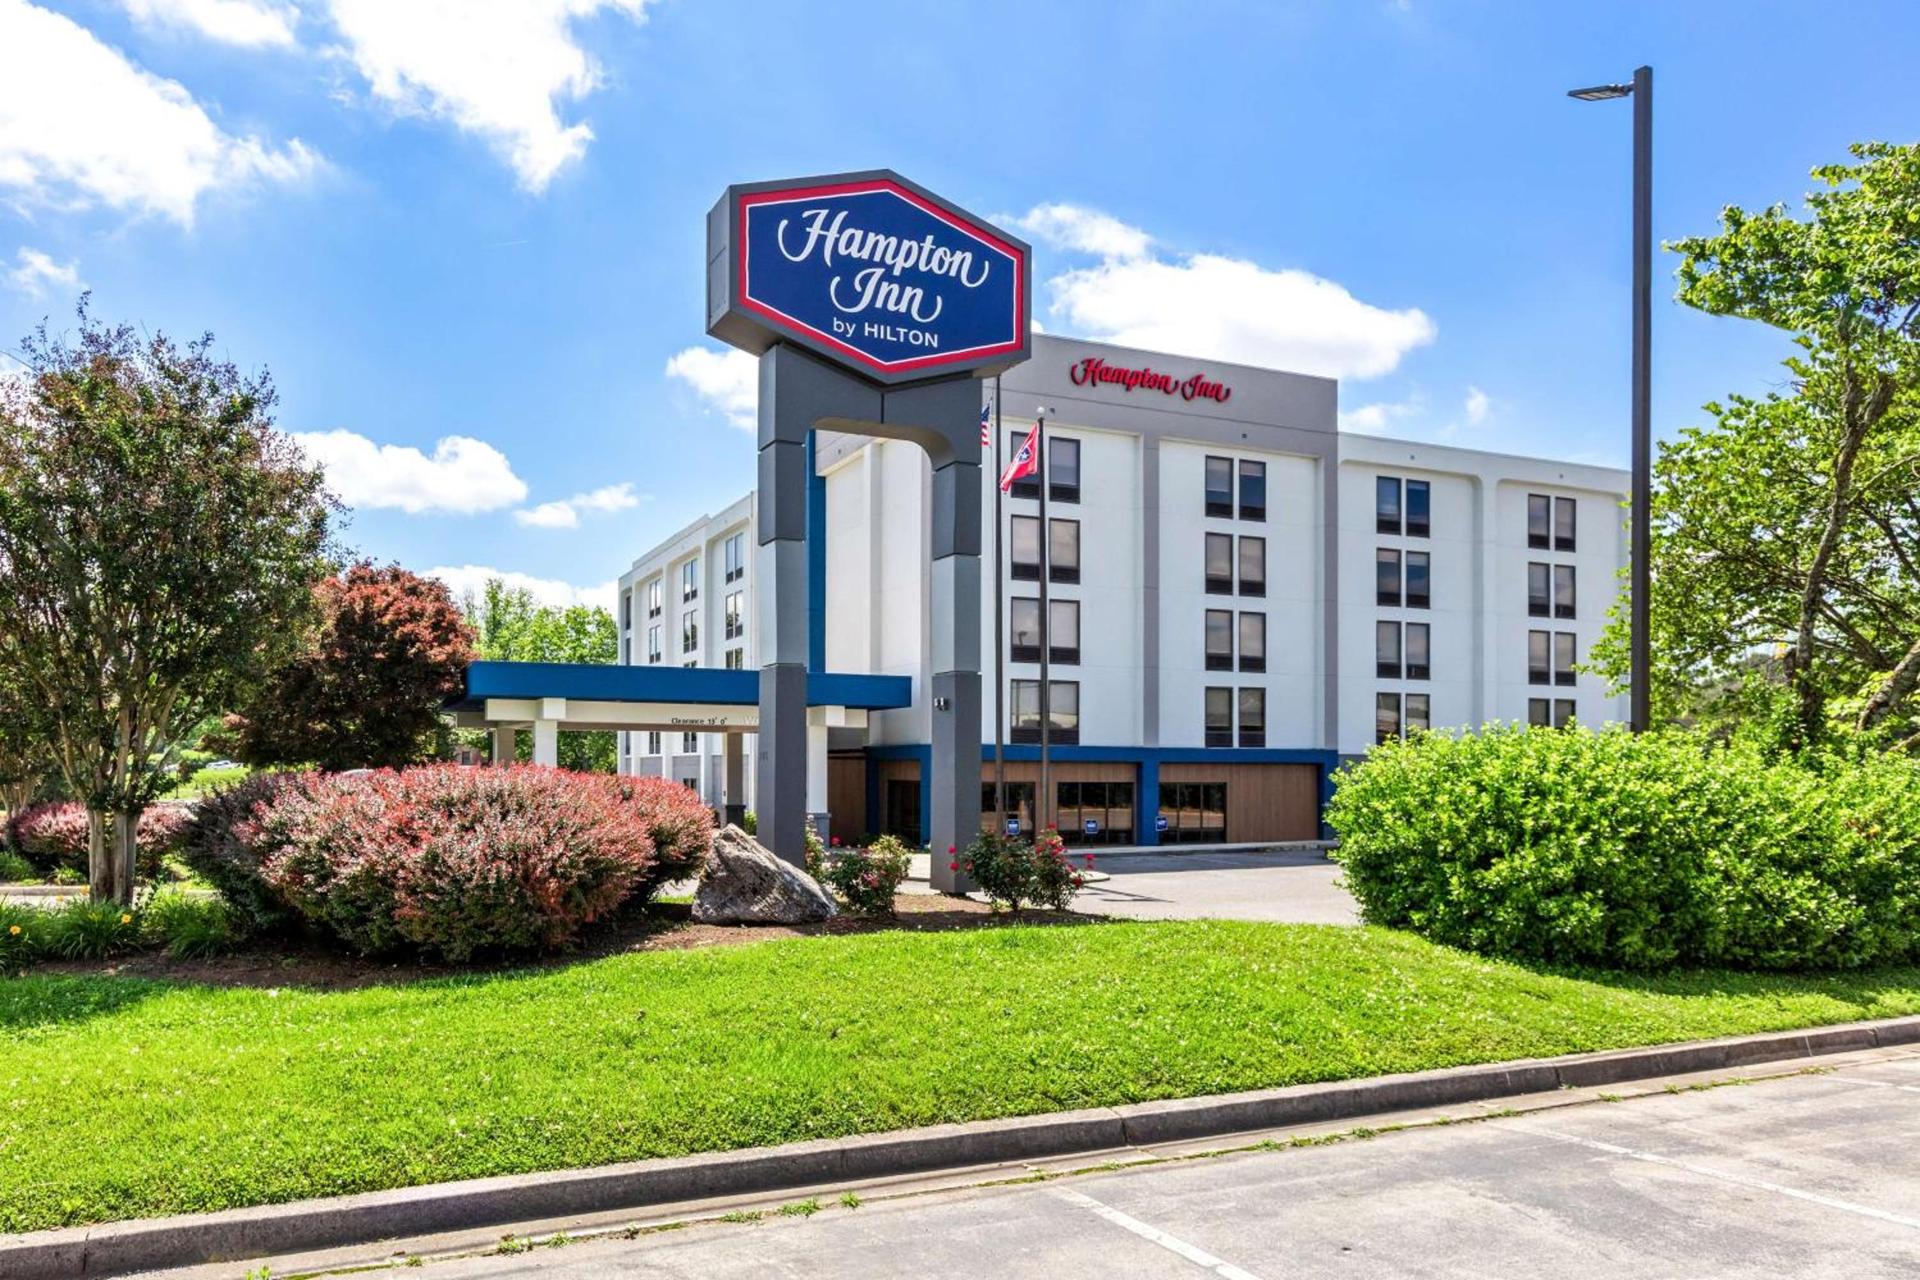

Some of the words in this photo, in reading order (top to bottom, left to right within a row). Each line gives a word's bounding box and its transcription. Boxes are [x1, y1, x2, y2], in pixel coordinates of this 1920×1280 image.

[777, 208, 989, 288] Hampton
[830, 268, 942, 323] Inn
[833, 316, 856, 337] by
[864, 321, 938, 348] HILTON
[1070, 357, 1180, 395] Hampton
[1181, 373, 1232, 402] Inn
